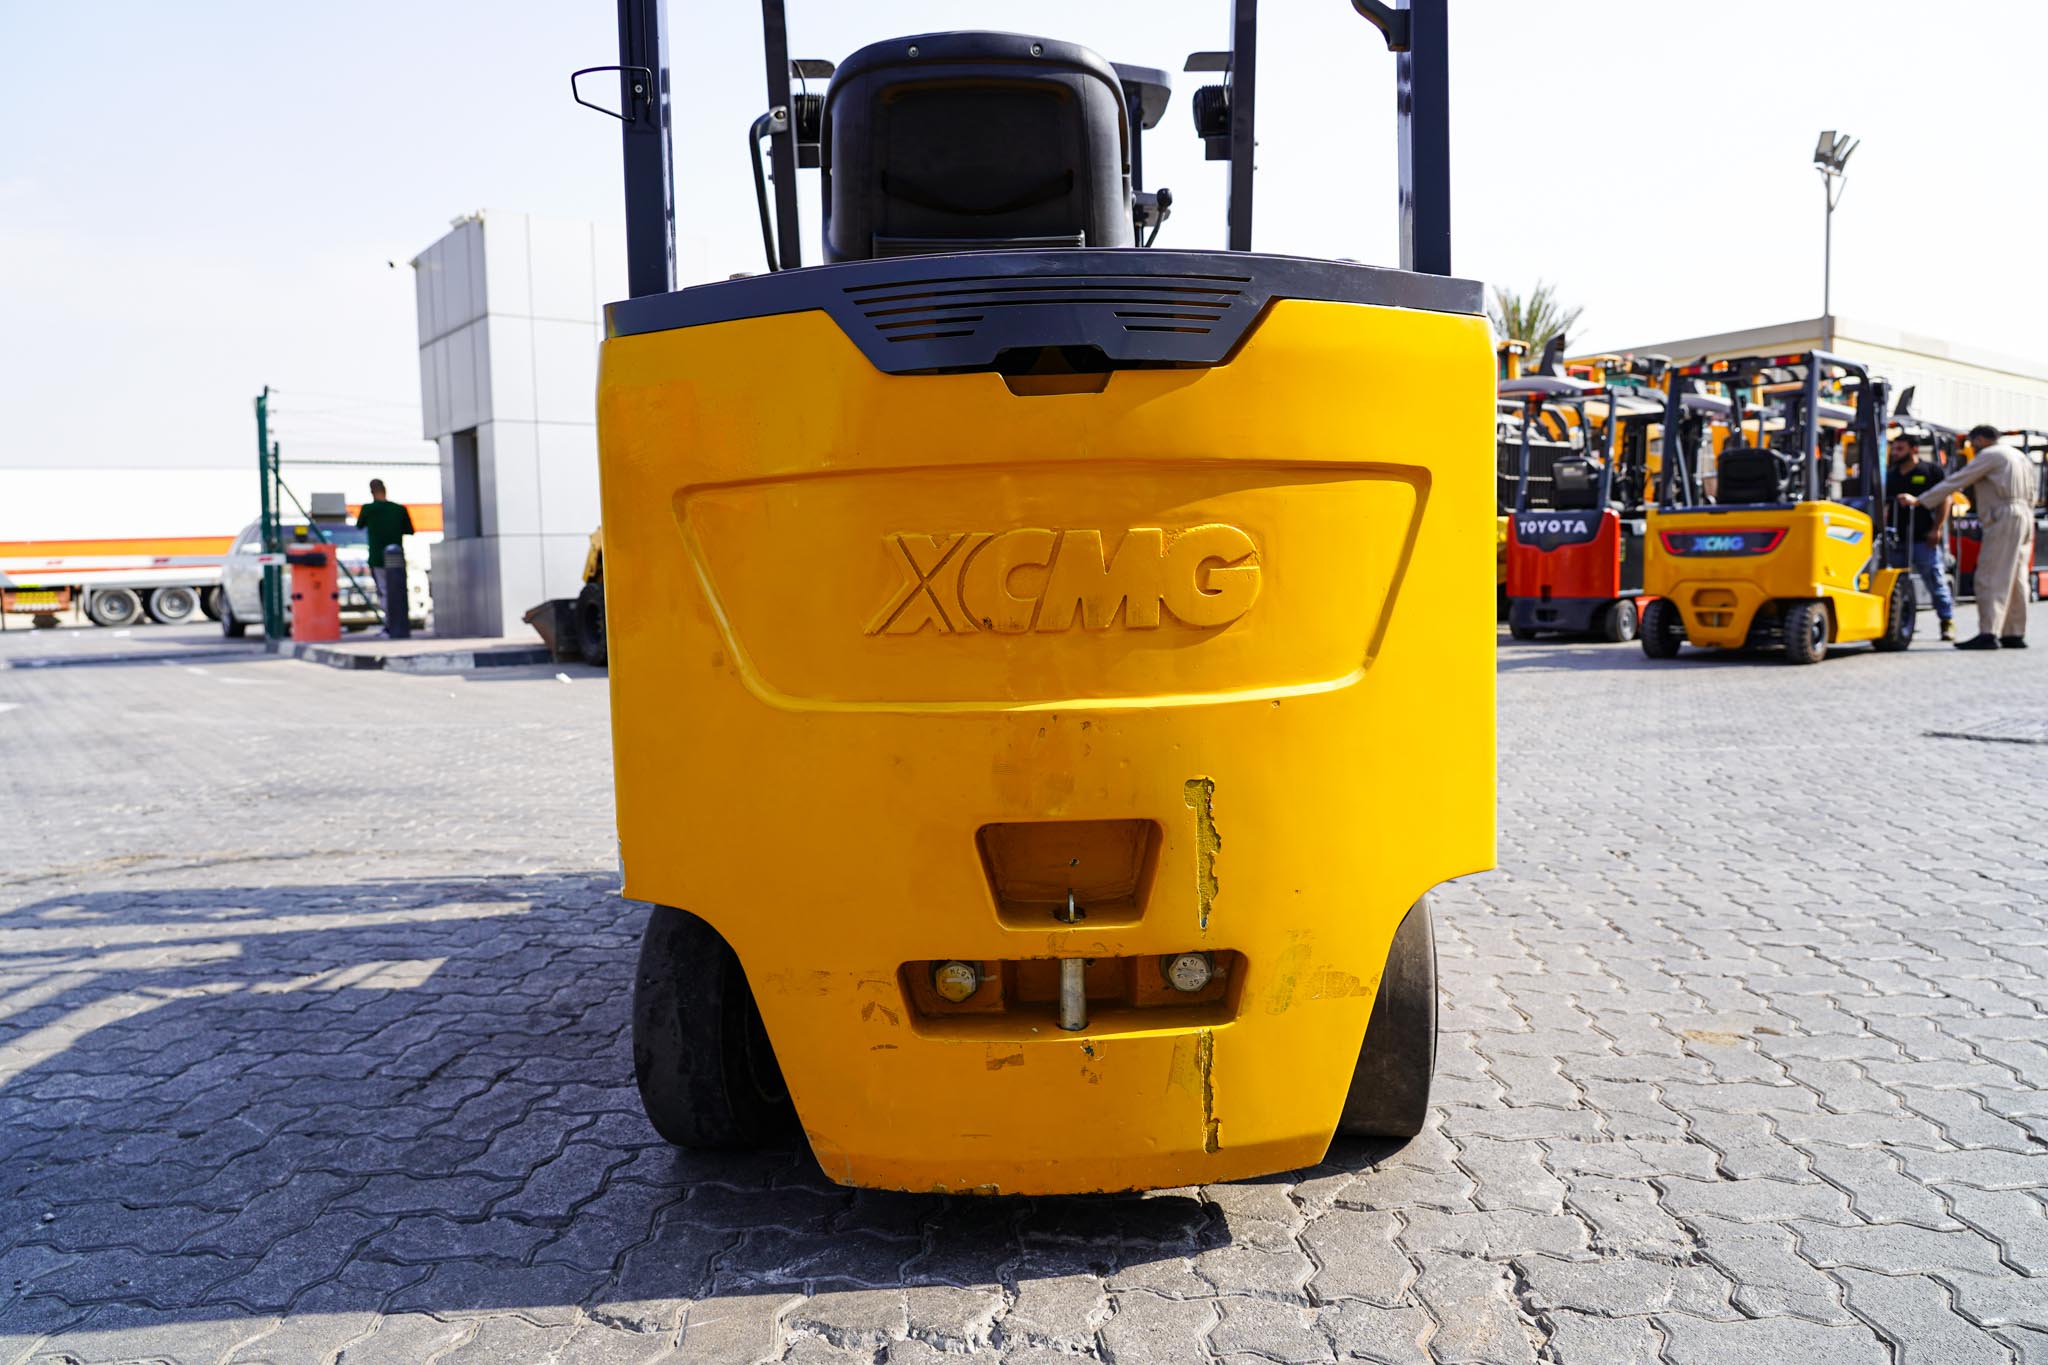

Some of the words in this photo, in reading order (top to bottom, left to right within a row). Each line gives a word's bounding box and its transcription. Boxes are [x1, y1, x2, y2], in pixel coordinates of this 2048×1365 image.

[1520, 519, 1588, 535] TOYOTA
[1692, 535, 1745, 552] XCMG
[864, 523, 1261, 635] XCMG
